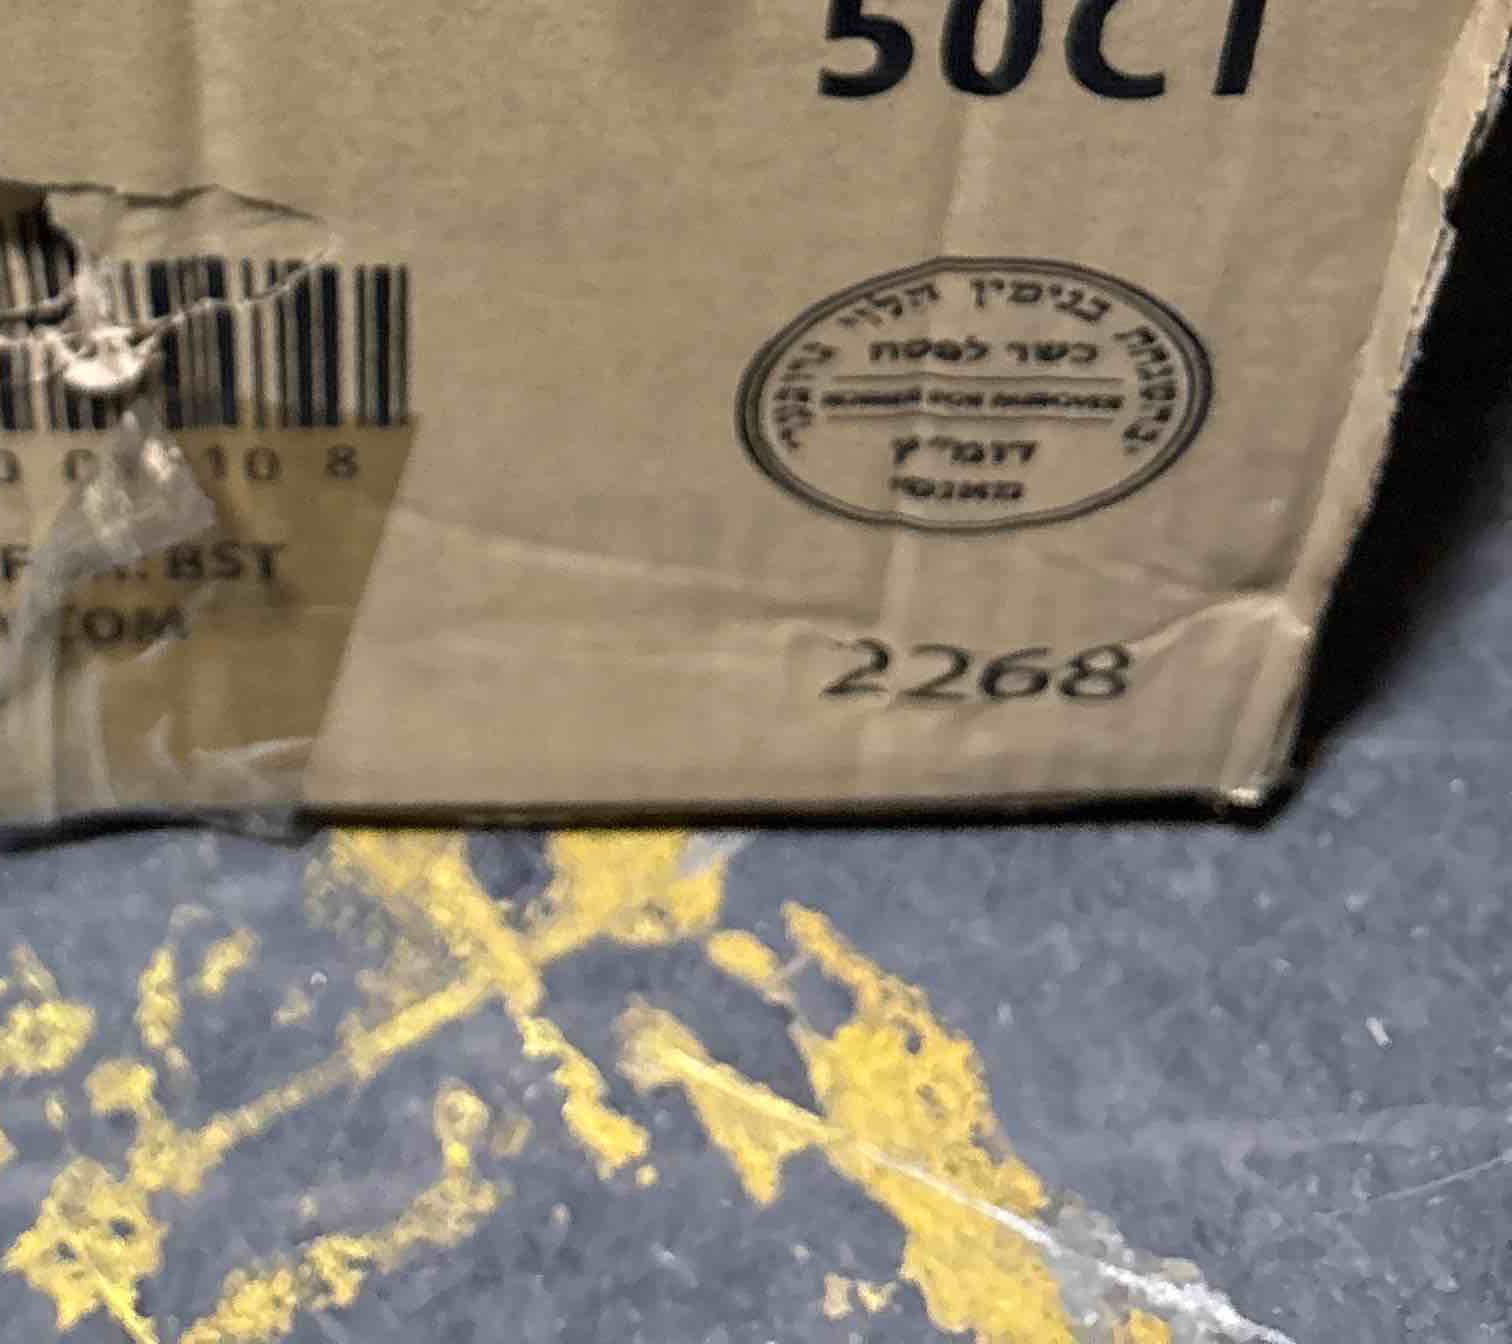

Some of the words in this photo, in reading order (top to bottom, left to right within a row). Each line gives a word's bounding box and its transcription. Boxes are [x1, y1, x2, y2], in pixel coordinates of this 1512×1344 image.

[1004, 339, 1101, 367] כשר
[325, 444, 360, 482] 8
[166, 543, 287, 581] BST
[819, 638, 1132, 701] 2268
